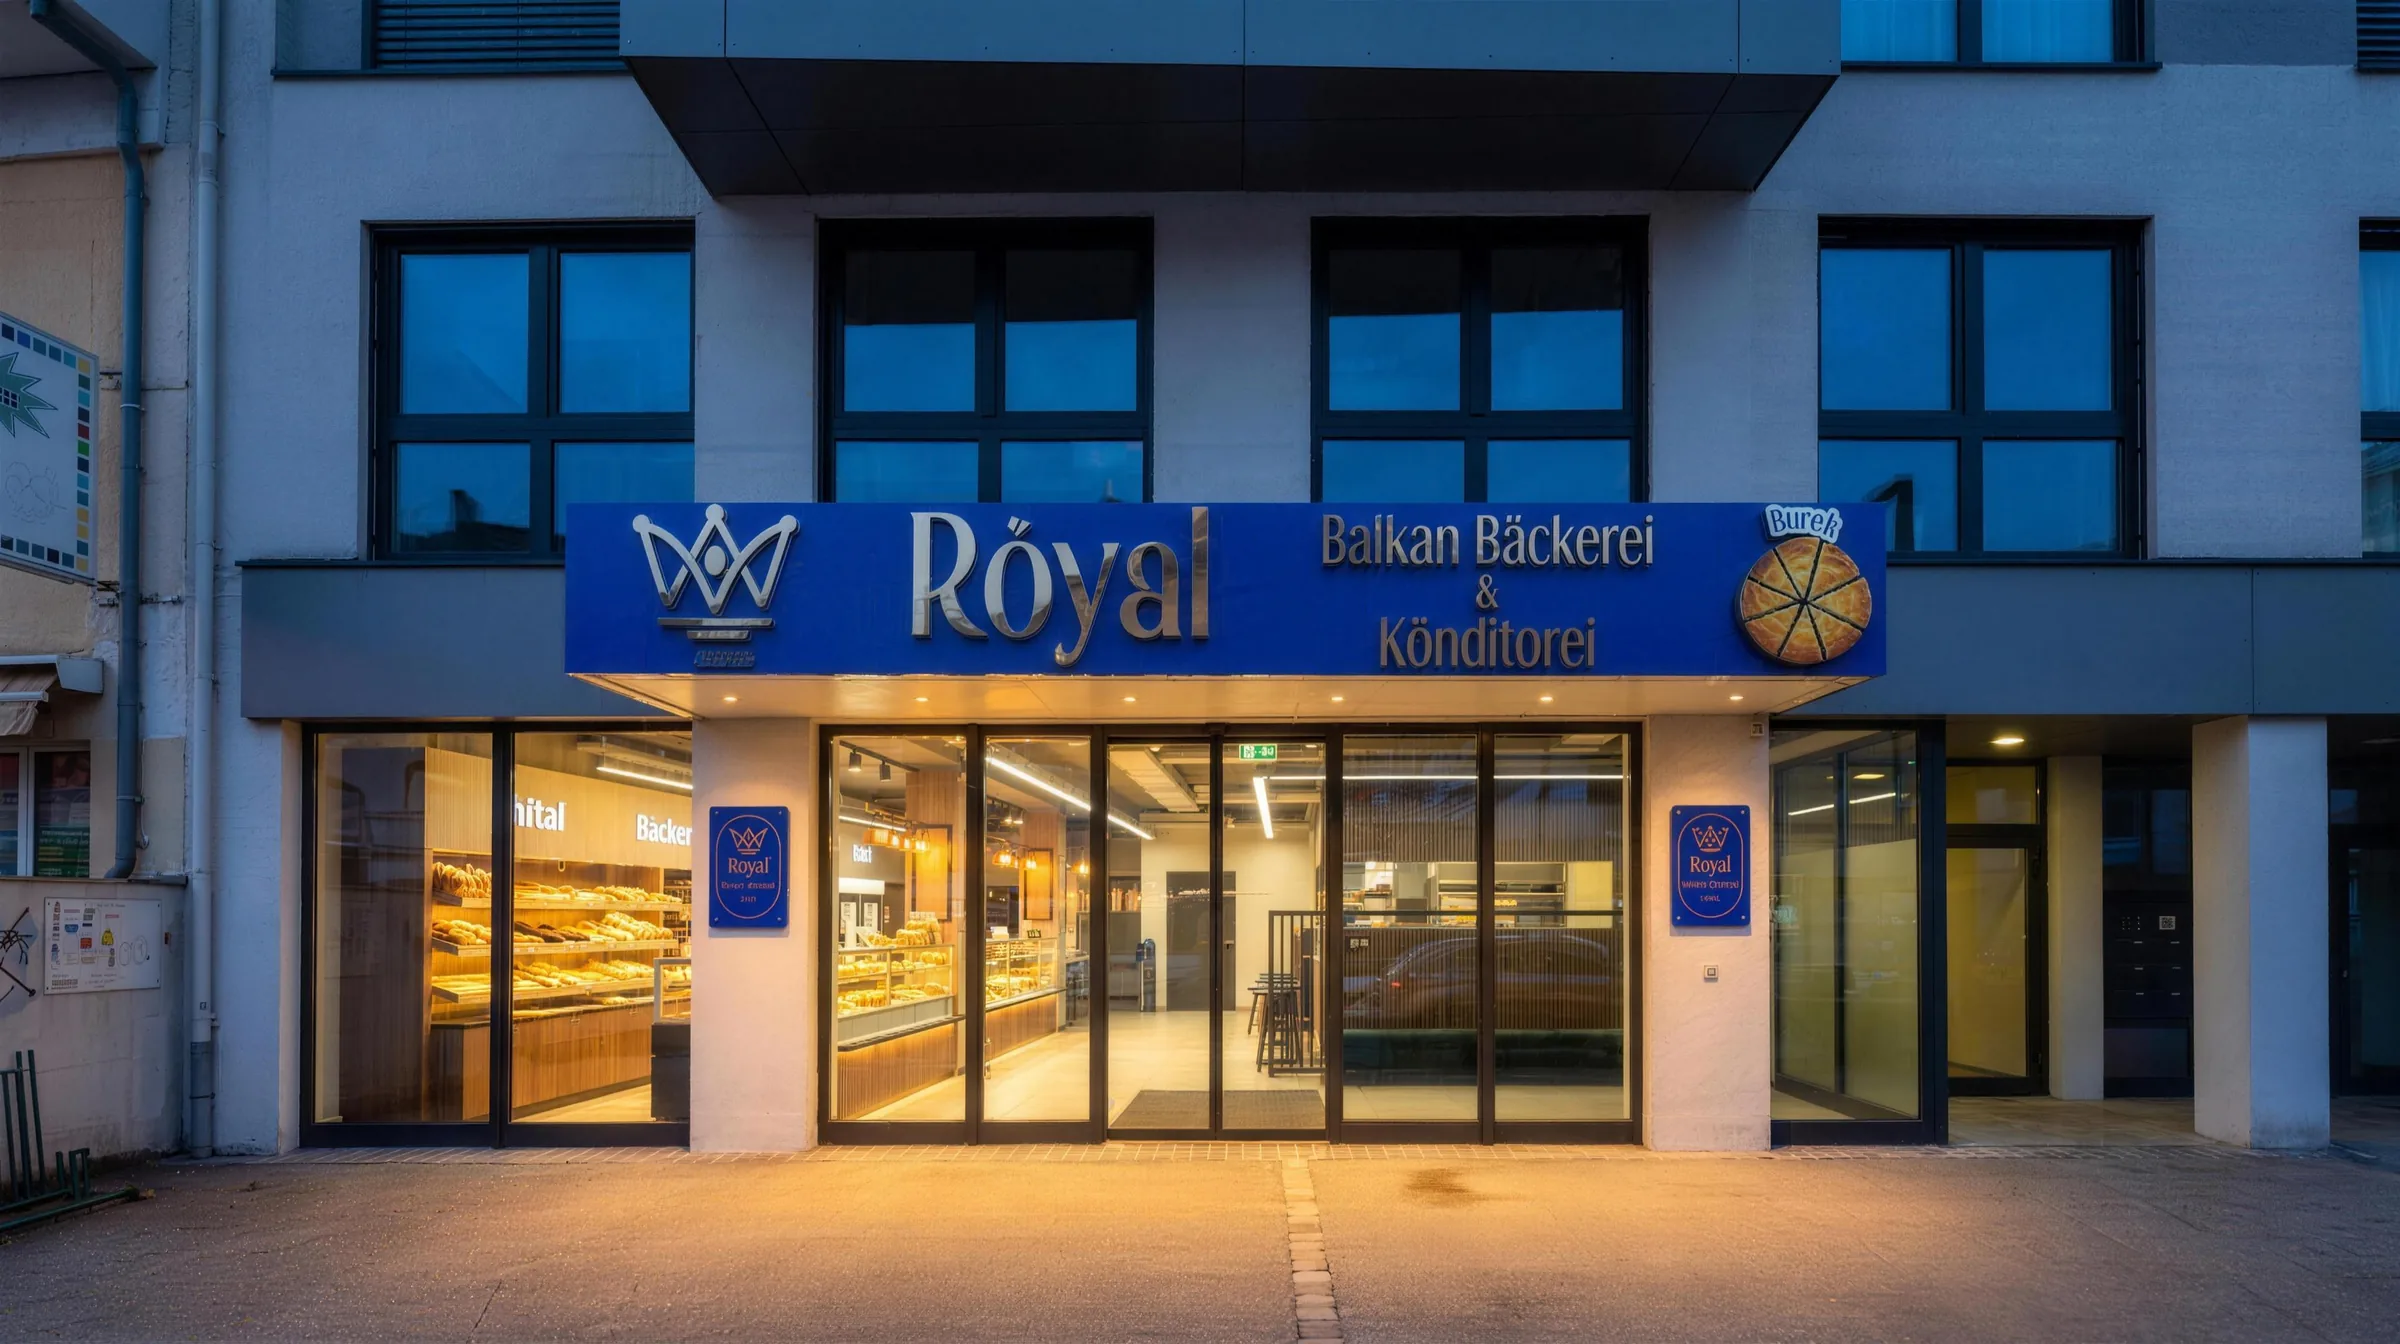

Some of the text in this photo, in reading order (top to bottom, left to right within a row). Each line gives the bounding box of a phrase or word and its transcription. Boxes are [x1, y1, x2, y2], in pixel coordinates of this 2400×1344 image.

[1321, 513, 1655, 568] Balkan Bäckerei
[1769, 508, 1838, 539] Burek
[1475, 573, 1499, 611] &
[1379, 616, 1597, 669] Könditorei
[727, 856, 769, 879] Royal
[1689, 854, 1732, 878] Royal
